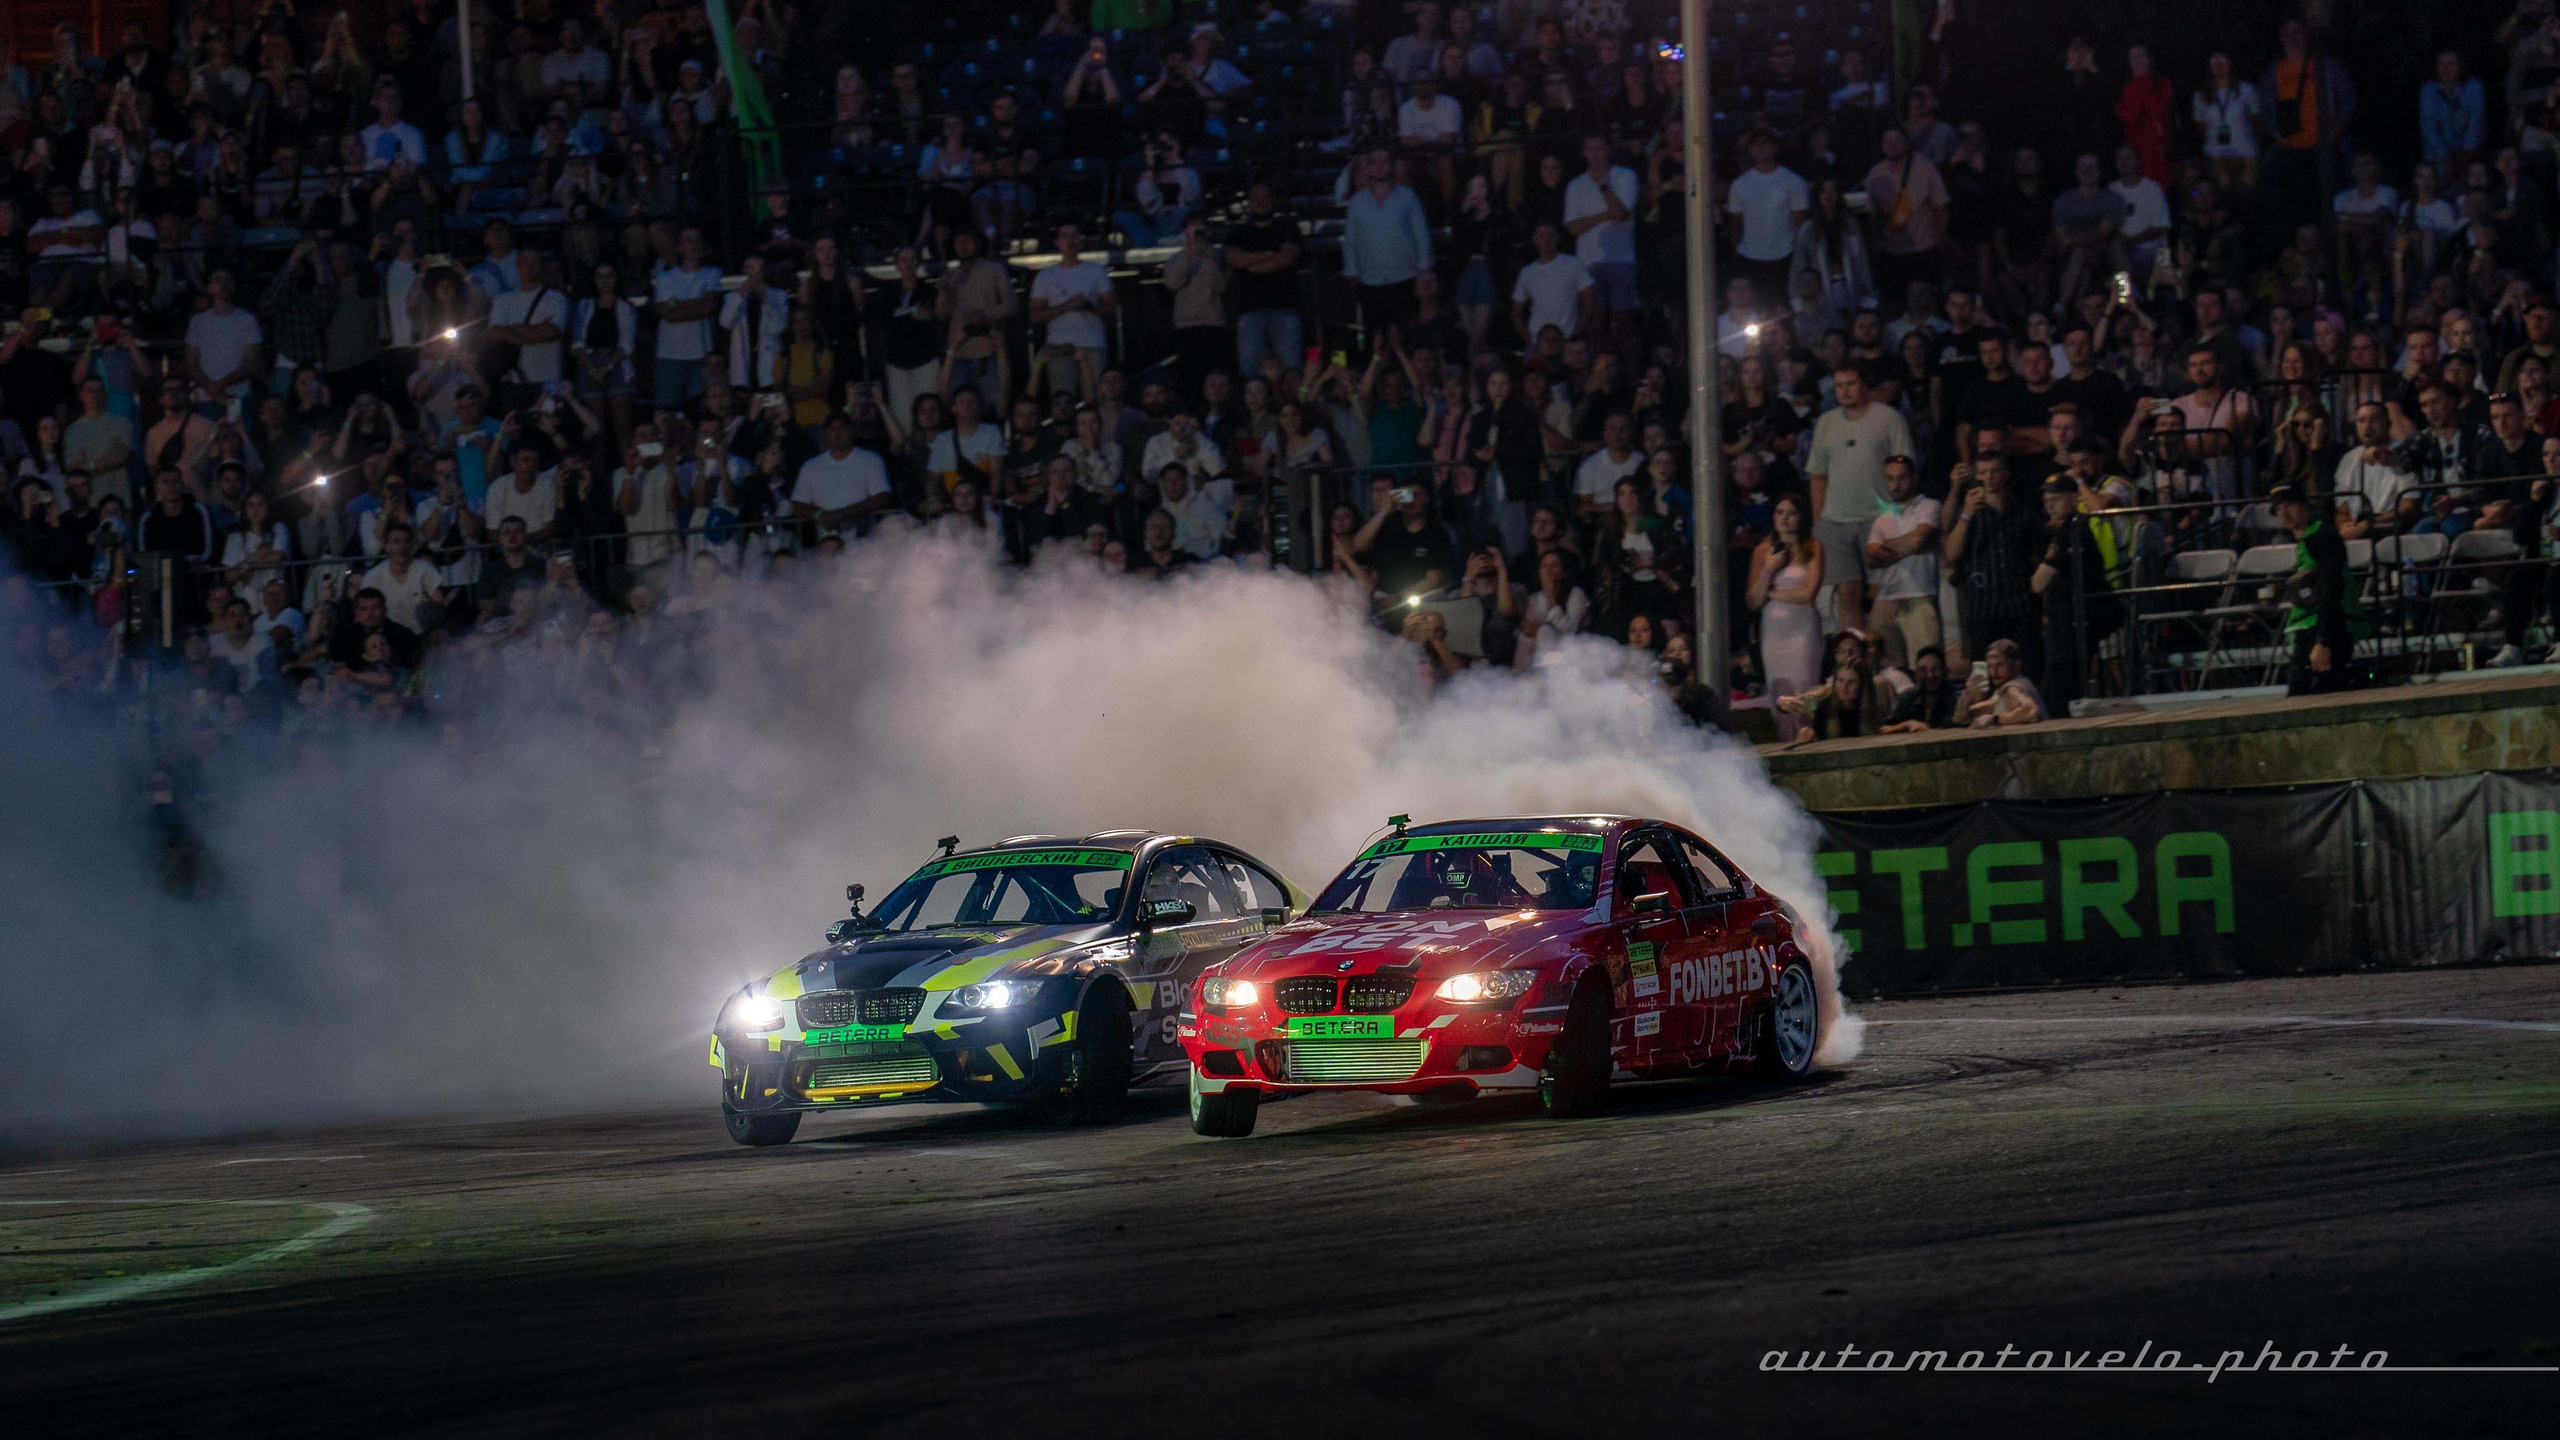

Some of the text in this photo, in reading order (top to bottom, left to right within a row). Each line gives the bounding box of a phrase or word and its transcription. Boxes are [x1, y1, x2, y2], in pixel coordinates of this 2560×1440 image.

[1439, 834, 1529, 847] КАПШАЙ
[951, 851, 1081, 871] ВИШНЕВСКИЙ
[1346, 858, 1392, 880] 17
[1446, 874, 1465, 882] OMP
[1288, 932, 1459, 956] BET
[1670, 944, 1778, 1006] FONBET.BY
